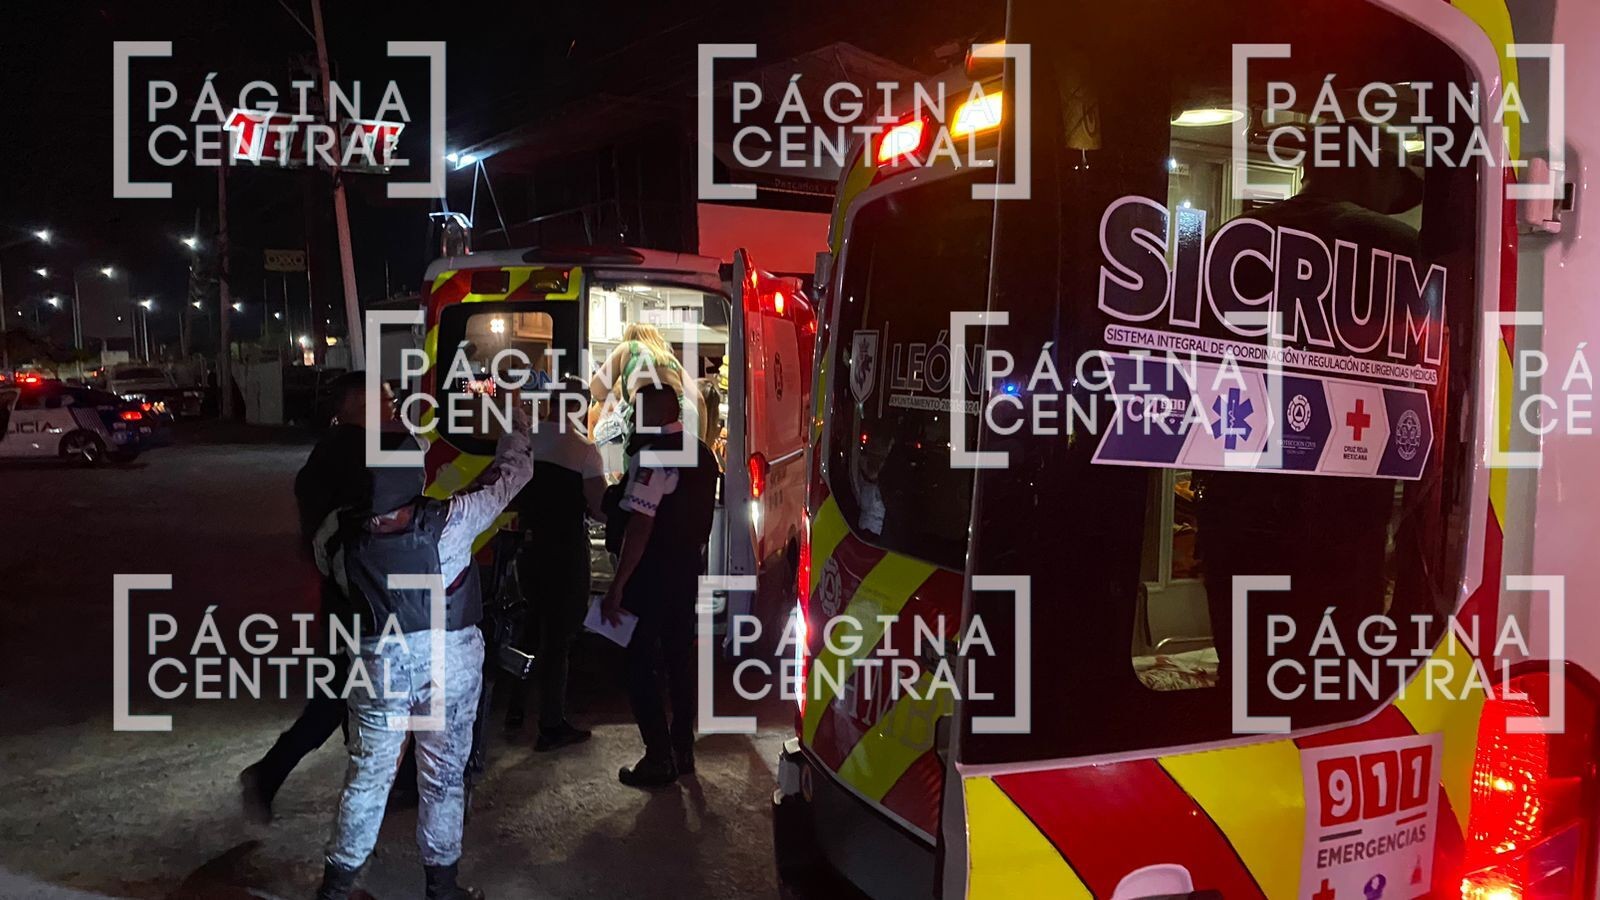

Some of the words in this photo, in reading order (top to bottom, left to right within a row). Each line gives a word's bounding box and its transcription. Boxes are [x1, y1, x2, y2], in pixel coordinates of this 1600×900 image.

[1098, 195, 1447, 365] SICRUM
[890, 331, 985, 395] LEÓN
[1107, 328, 1154, 345] SISTEMA
[1158, 335, 1208, 352] INTEGRAL
[1211, 343, 1223, 355] DE
[1226, 344, 1298, 363] COORDINACIÓN
[1301, 354, 1308, 364] Y
[1309, 356, 1358, 371] REGULACIÓN
[1360, 362, 1370, 373] DE
[1371, 364, 1409, 379] URGENCIAS
[1410, 368, 1437, 382] MÉDICAS
[891, 396, 940, 411] AYUNTAMIENTO
[1326, 753, 1425, 818] 911
[1317, 824, 1427, 868] EMERGENCIAS
